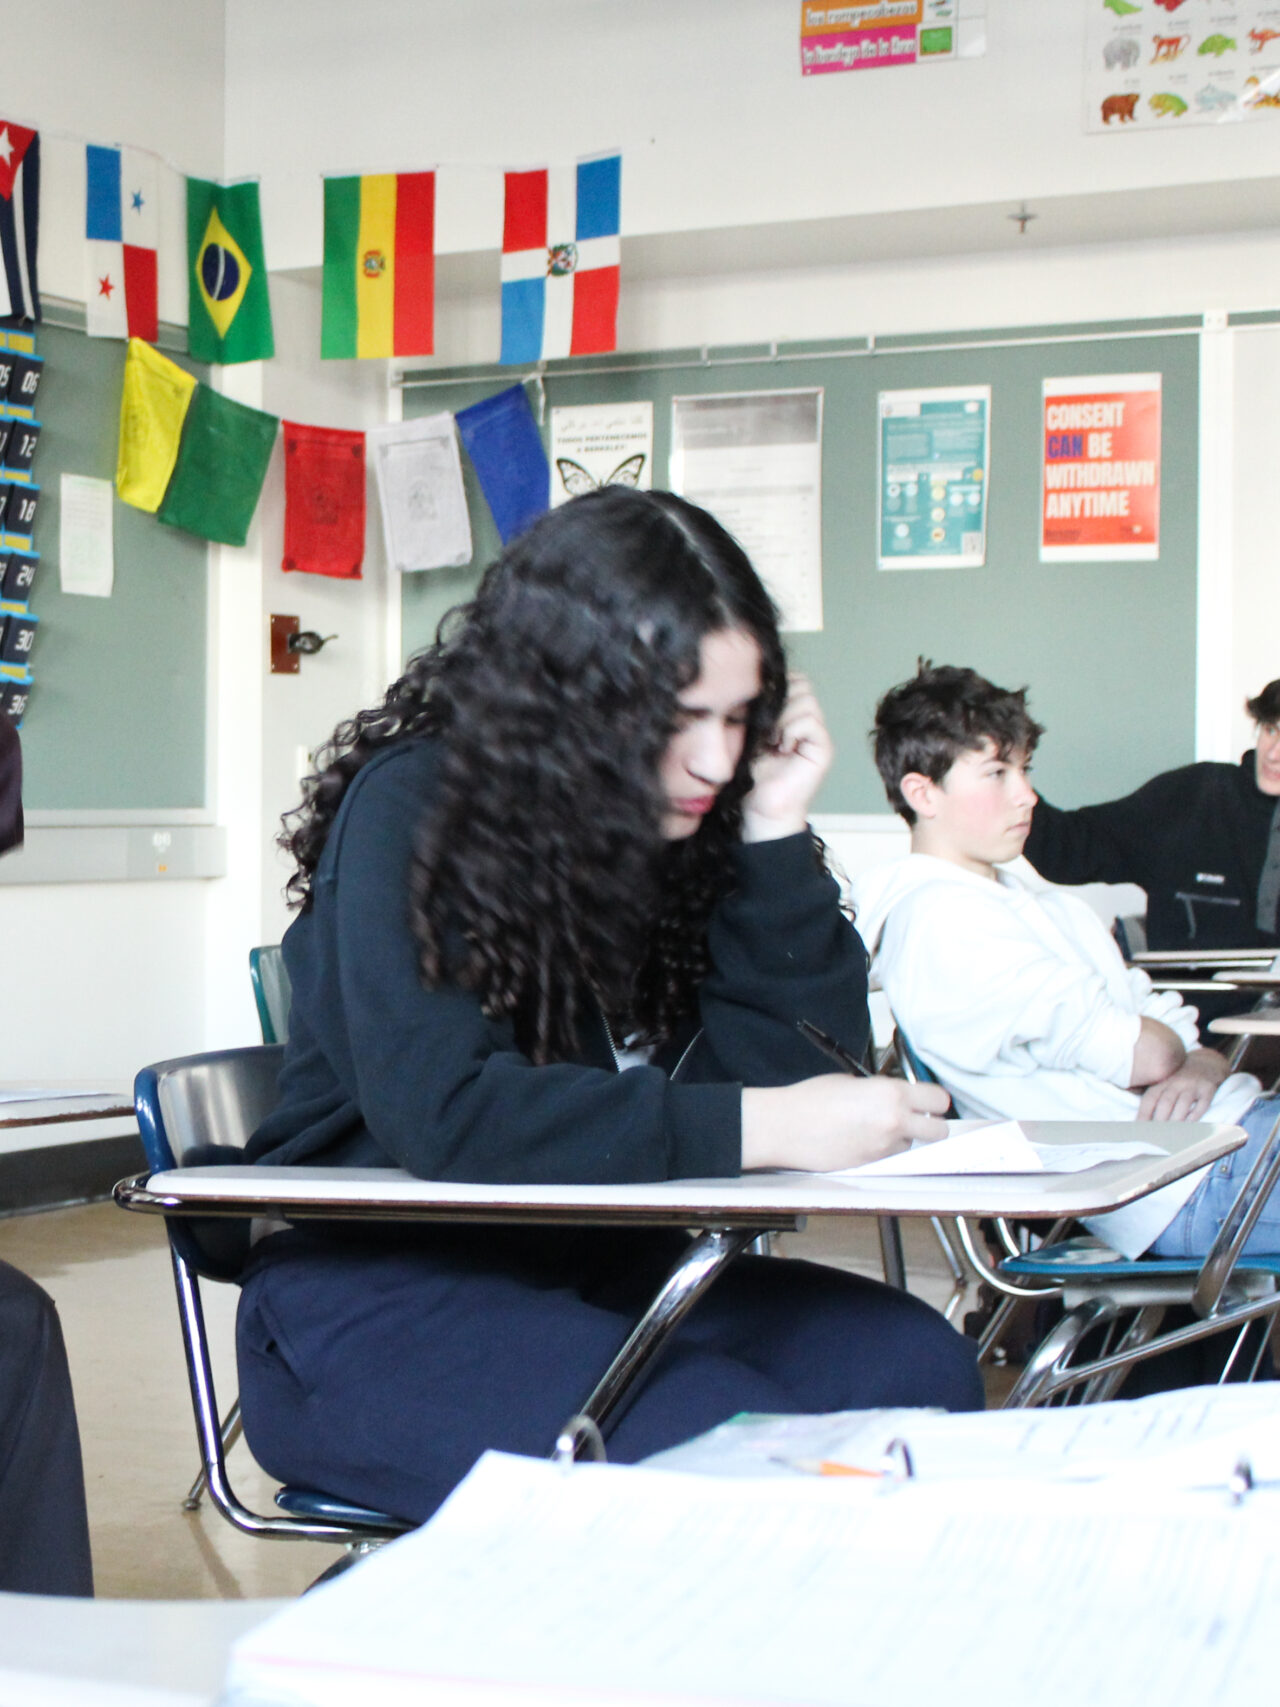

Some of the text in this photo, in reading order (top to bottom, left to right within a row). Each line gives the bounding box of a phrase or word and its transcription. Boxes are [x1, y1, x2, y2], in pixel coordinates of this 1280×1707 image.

[21, 370, 40, 393] 06
[1046, 402, 1125, 431] CONSENT
[20, 434, 36, 457] 12
[1047, 432, 1112, 459] CAN BE
[1045, 460, 1156, 489] WITHDRAWN
[20, 499, 36, 522] 18
[1046, 490, 1130, 519] ANYTIME
[16, 565, 35, 587] 24
[15, 629, 34, 651] 30
[8, 695, 28, 715] 36
